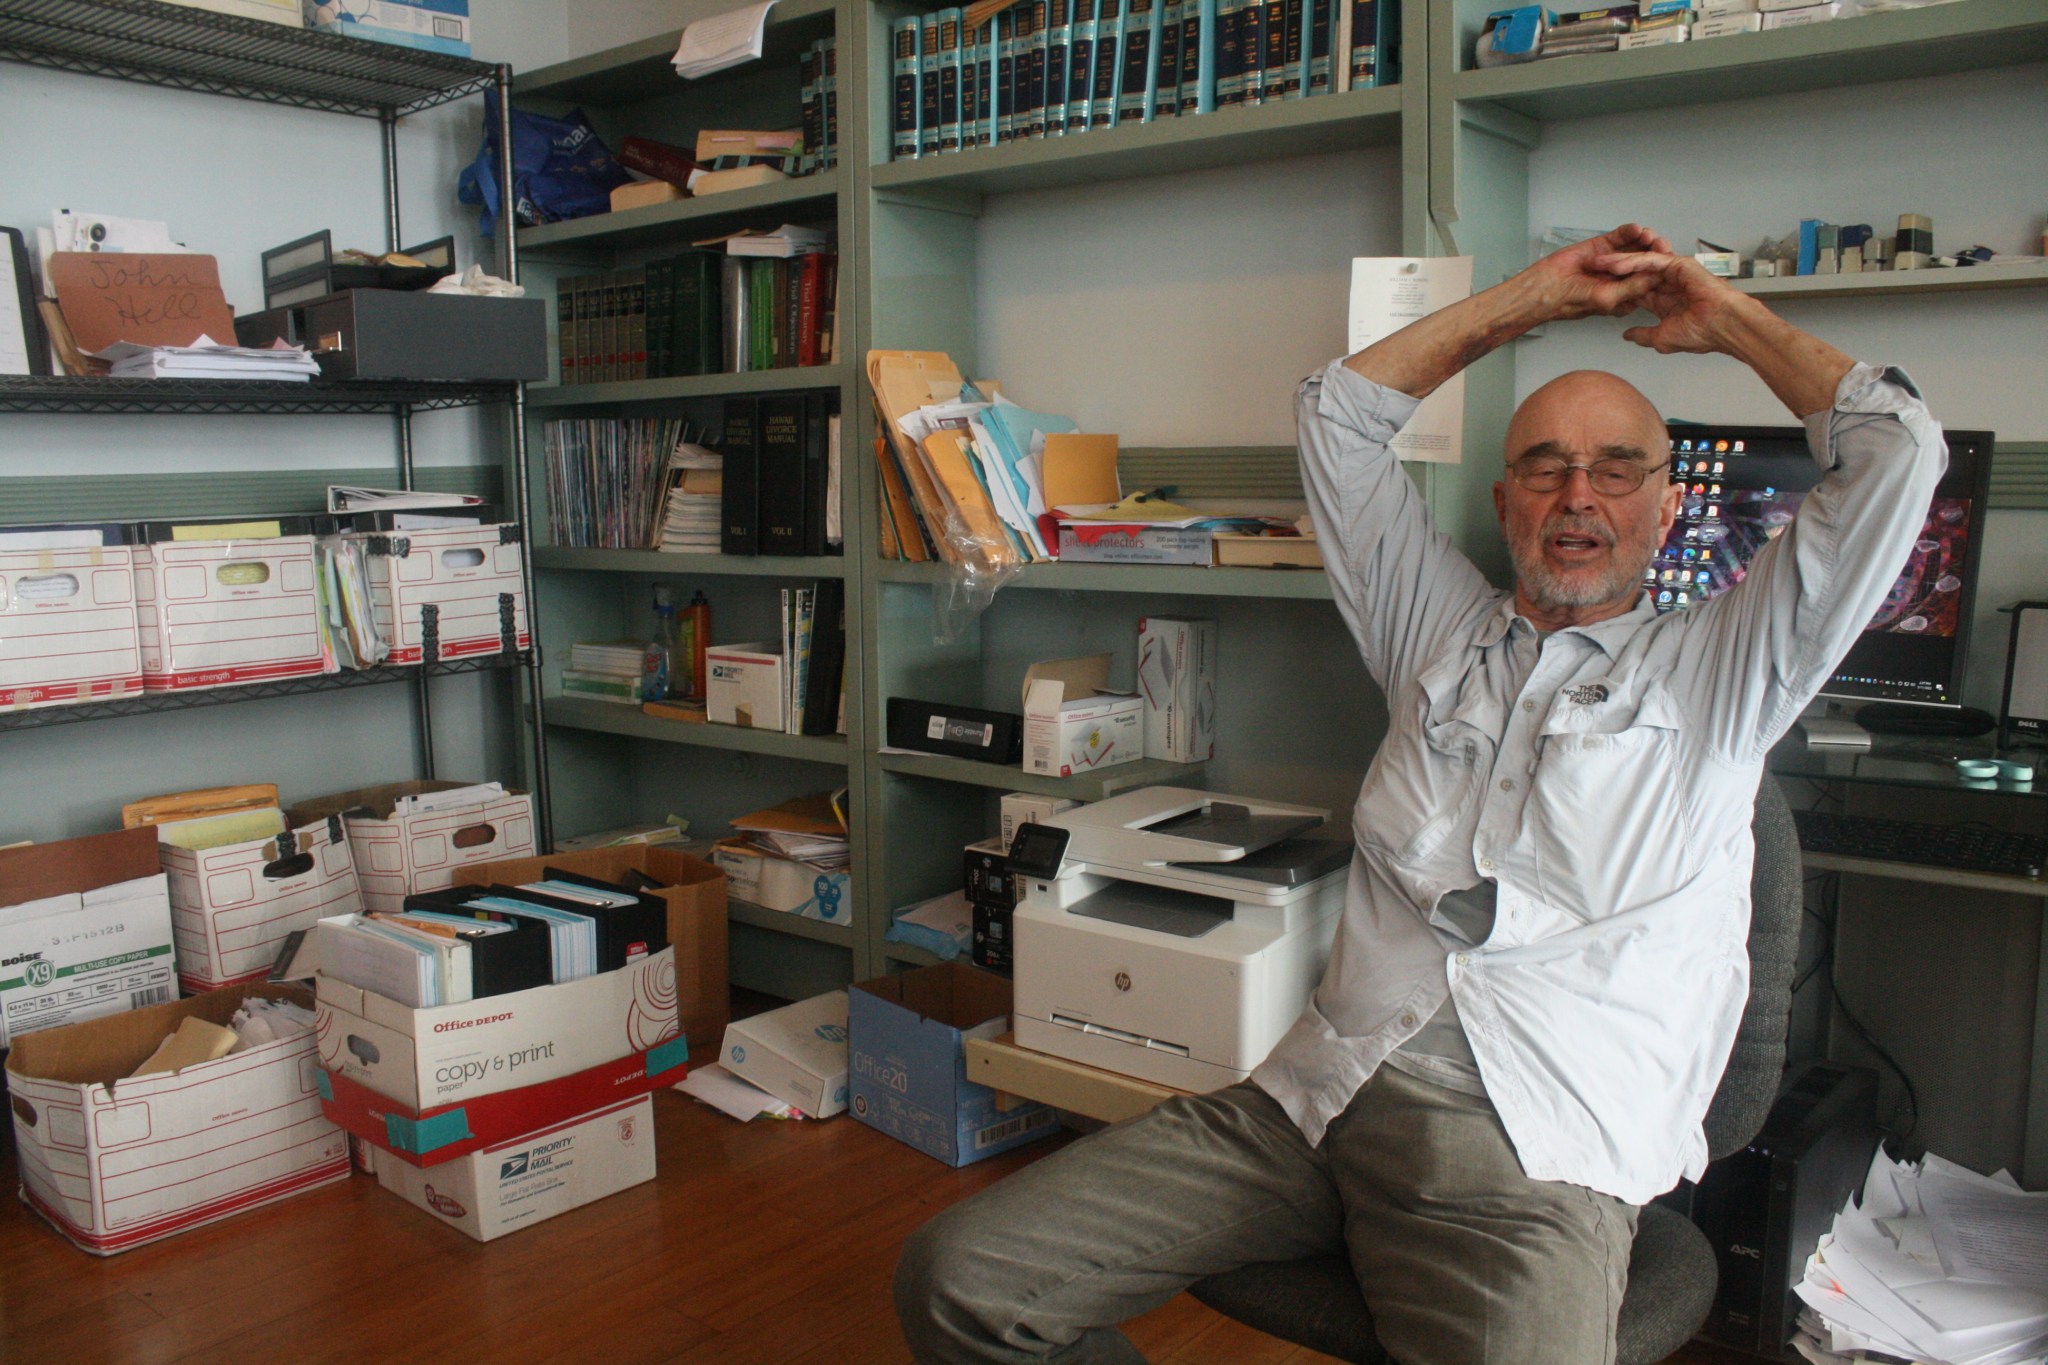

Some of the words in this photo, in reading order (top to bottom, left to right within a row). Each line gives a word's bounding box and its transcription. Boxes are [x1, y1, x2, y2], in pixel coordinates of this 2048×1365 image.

[90, 259, 200, 289] John
[765, 425, 798, 434] DIVORCE
[767, 435, 796, 443] MANUAL
[771, 527, 786, 535] VOL
[1093, 537, 1145, 549] protectors
[177, 675, 198, 684] basic
[199, 671, 231, 683] strength
[1561, 688, 1596, 698] NORTH
[1578, 684, 1597, 692] THE
[1569, 697, 1598, 705] FACE
[2017, 720, 2039, 728] DELL
[73, 959, 108, 973] MULTI-USE
[108, 955, 126, 965] COPY
[127, 950, 149, 961] PAPER
[29, 963, 51, 984] X9
[1115, 972, 1131, 991] hp
[433, 1019, 474, 1033] Office
[475, 1012, 514, 1026] DEPOT
[435, 1057, 489, 1084] copy
[493, 1055, 504, 1071] &
[508, 1041, 555, 1072] print
[731, 1045, 746, 1064] hp
[613, 1069, 644, 1087] DEPOT
[854, 1051, 908, 1094] Office20
[436, 1080, 464, 1095] paper
[532, 1136, 574, 1157] PRIORITY
[530, 1155, 553, 1170] MAIL
[499, 1178, 519, 1189] UNITED
[554, 1160, 574, 1170] SERVICE
[1729, 1243, 1761, 1260] APC
